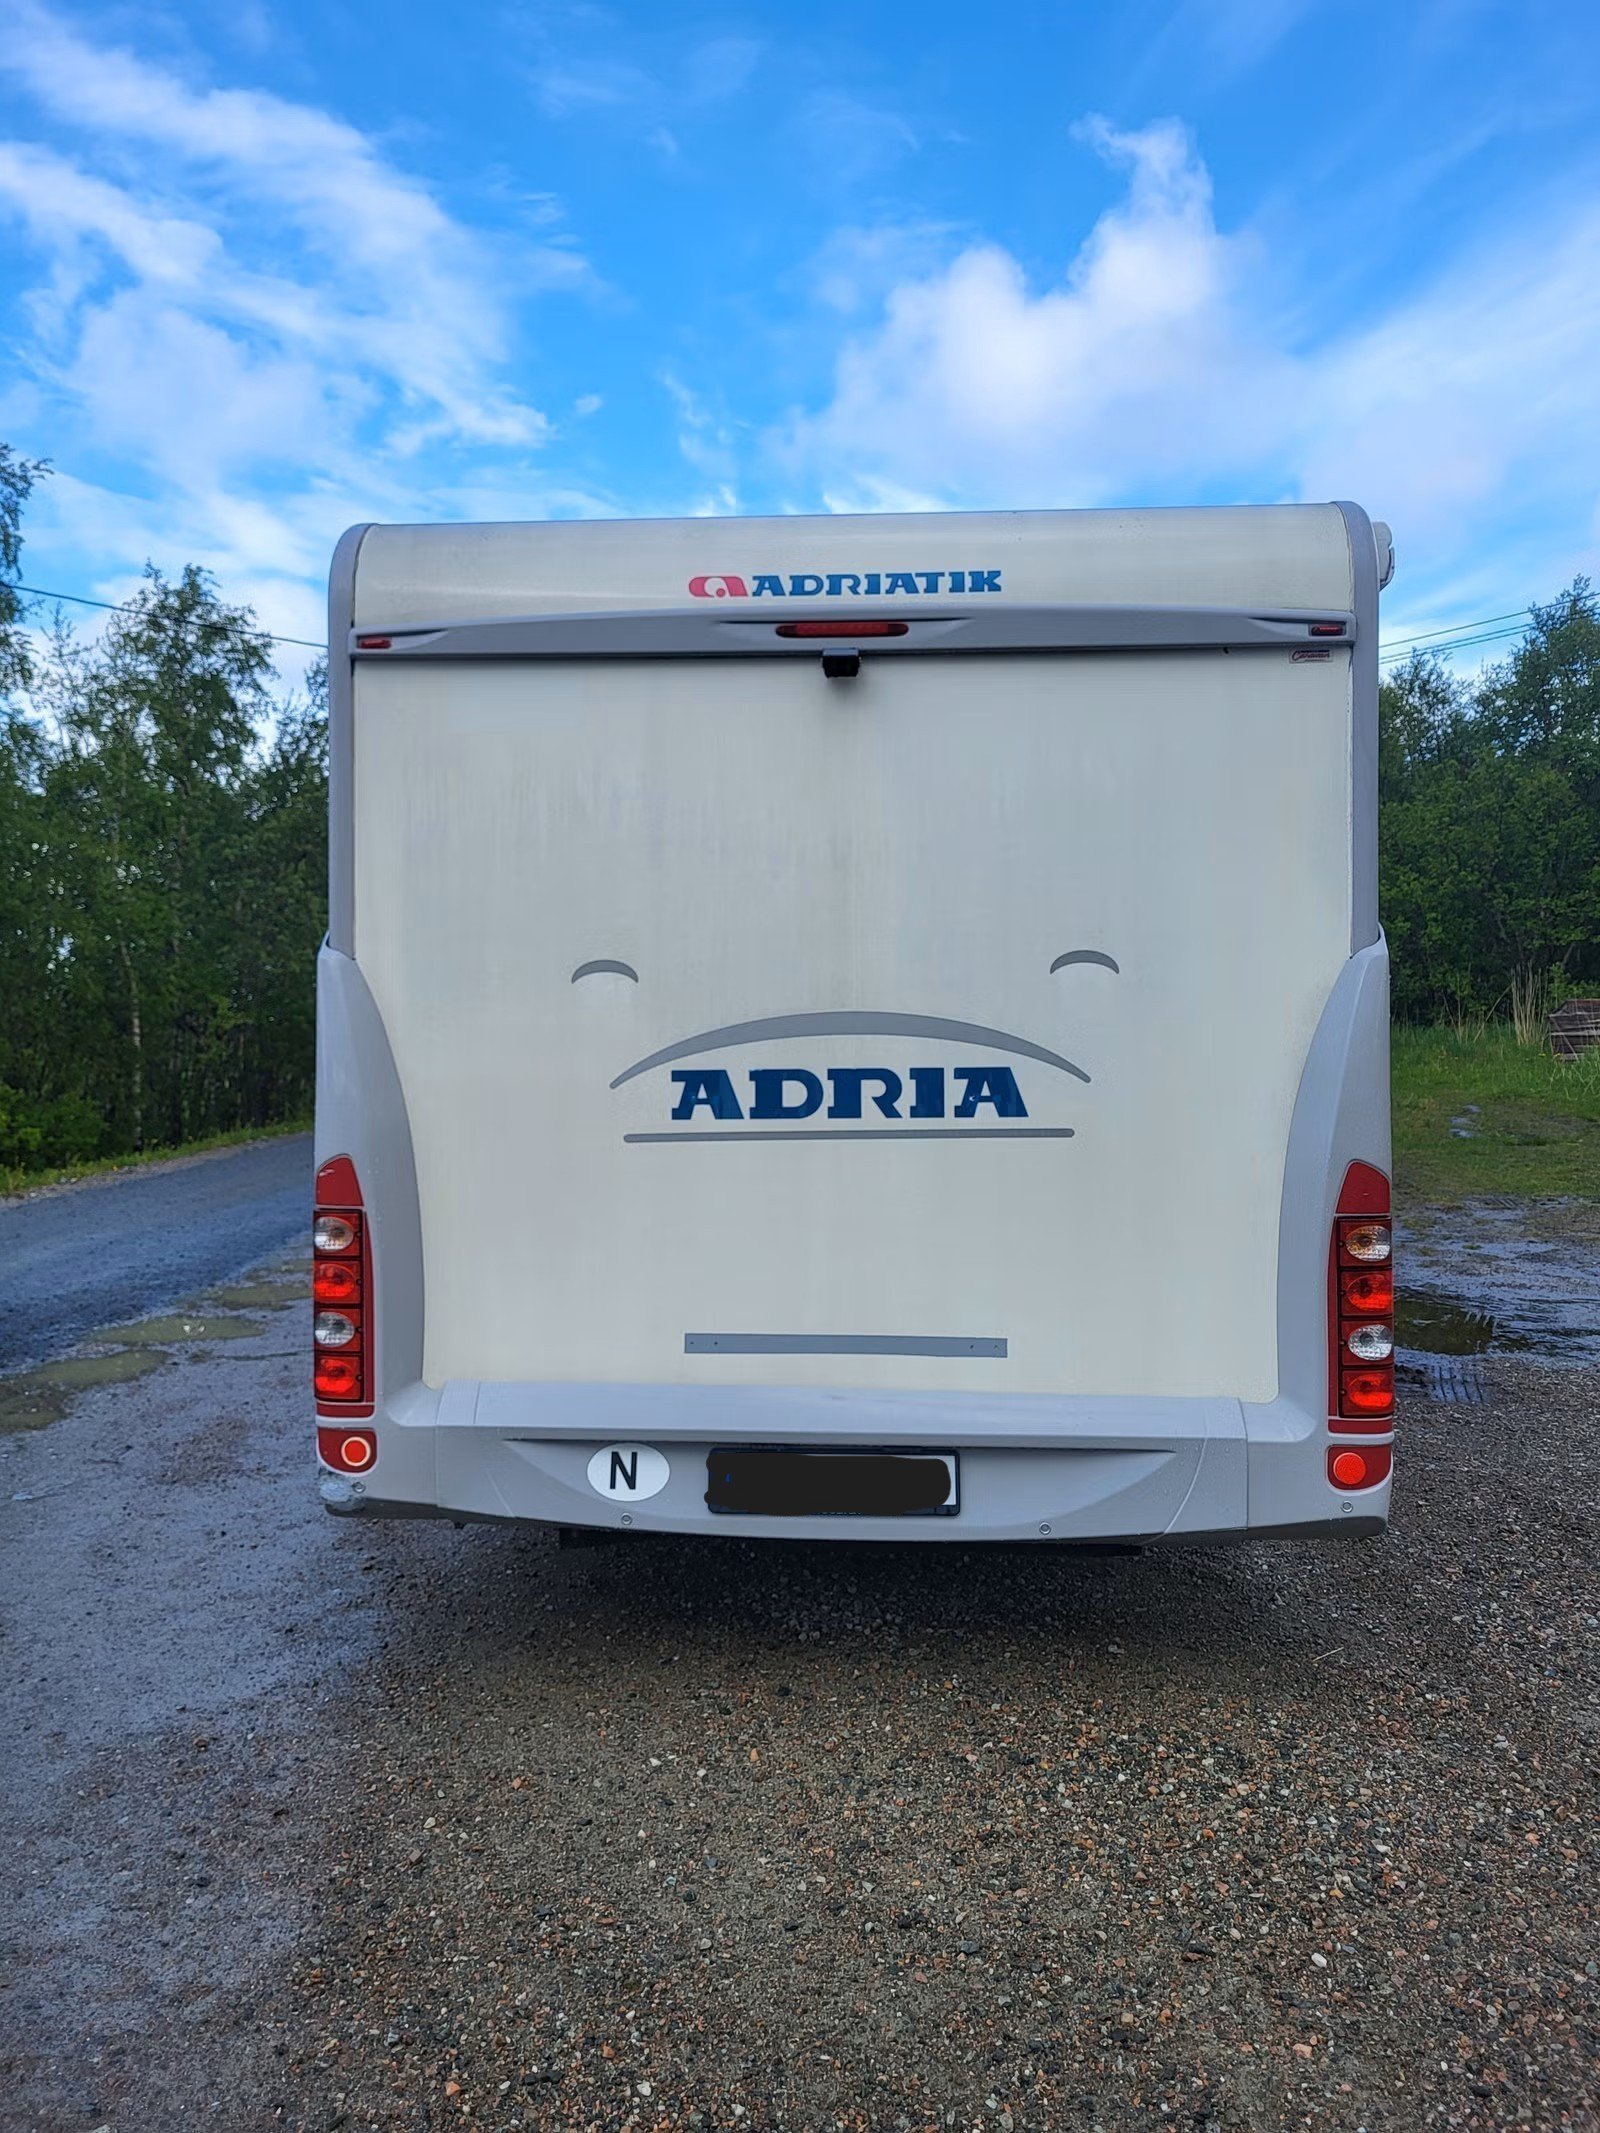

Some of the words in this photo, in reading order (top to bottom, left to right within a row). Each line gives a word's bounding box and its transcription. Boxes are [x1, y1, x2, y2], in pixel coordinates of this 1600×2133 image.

[752, 570, 1002, 597] ADRIATIK
[671, 1066, 1029, 1120] ADRIA
[610, 1451, 638, 1490] N
